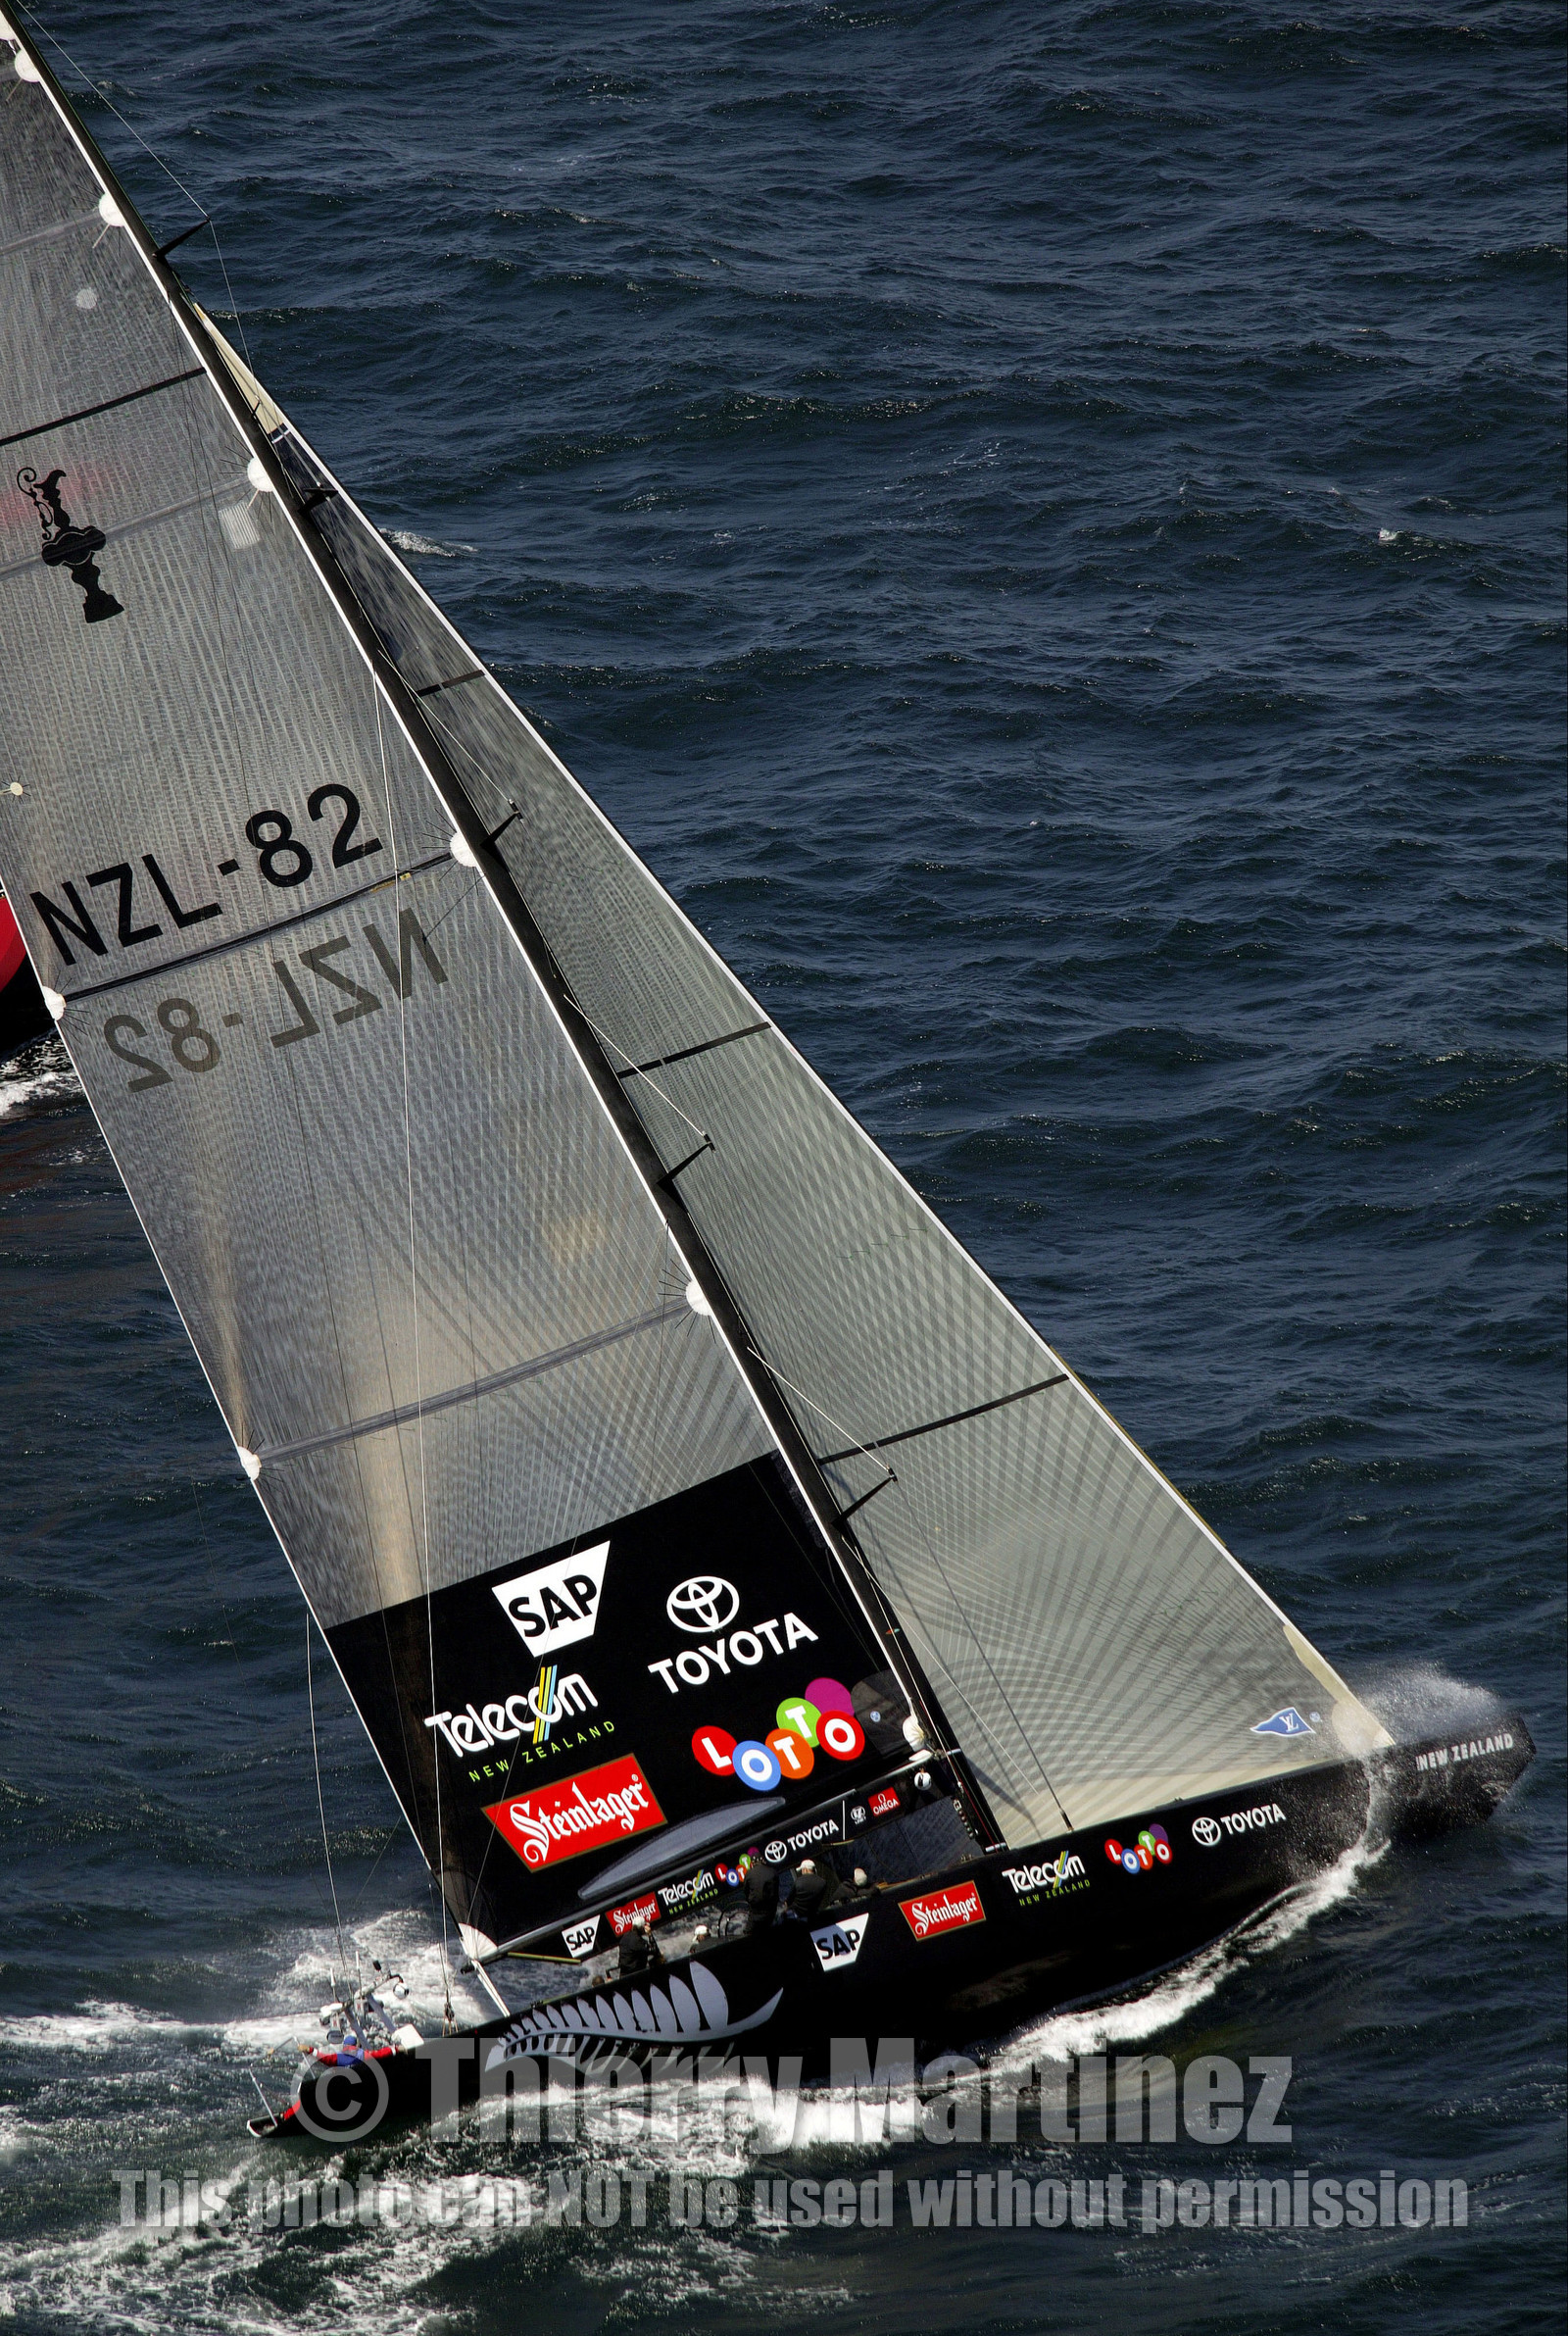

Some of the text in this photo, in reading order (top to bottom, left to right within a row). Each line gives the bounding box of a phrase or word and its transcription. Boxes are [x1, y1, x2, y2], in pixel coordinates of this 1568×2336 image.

[29, 783, 384, 967] NZL-82
[508, 1573, 599, 1638] SAP
[647, 1612, 819, 1694] TOYOTA
[424, 1671, 600, 1759] Telecom
[468, 1720, 615, 1782] NEW ZEALAND
[700, 1704, 858, 1783] LOTTO
[1415, 1732, 1514, 1771] NEW ZEALAND
[510, 1779, 649, 1863] Steinlager
[872, 1798, 899, 1815] OMEGA
[1220, 1803, 1287, 1837] TOYOTA
[787, 1818, 840, 1852] TOYOTA
[1108, 1834, 1171, 1870] LOTTO
[658, 1870, 714, 1906] Telecom
[716, 1855, 753, 1884] LOTT
[1002, 1855, 1086, 1894] Telecom
[668, 1888, 718, 1914] NEW ZEALAND
[1019, 1879, 1091, 1907] NEW ZEALAND
[911, 1893, 978, 1935] Steinlager
[565, 1925, 596, 1952] SAP
[815, 1927, 861, 1961] SAP
